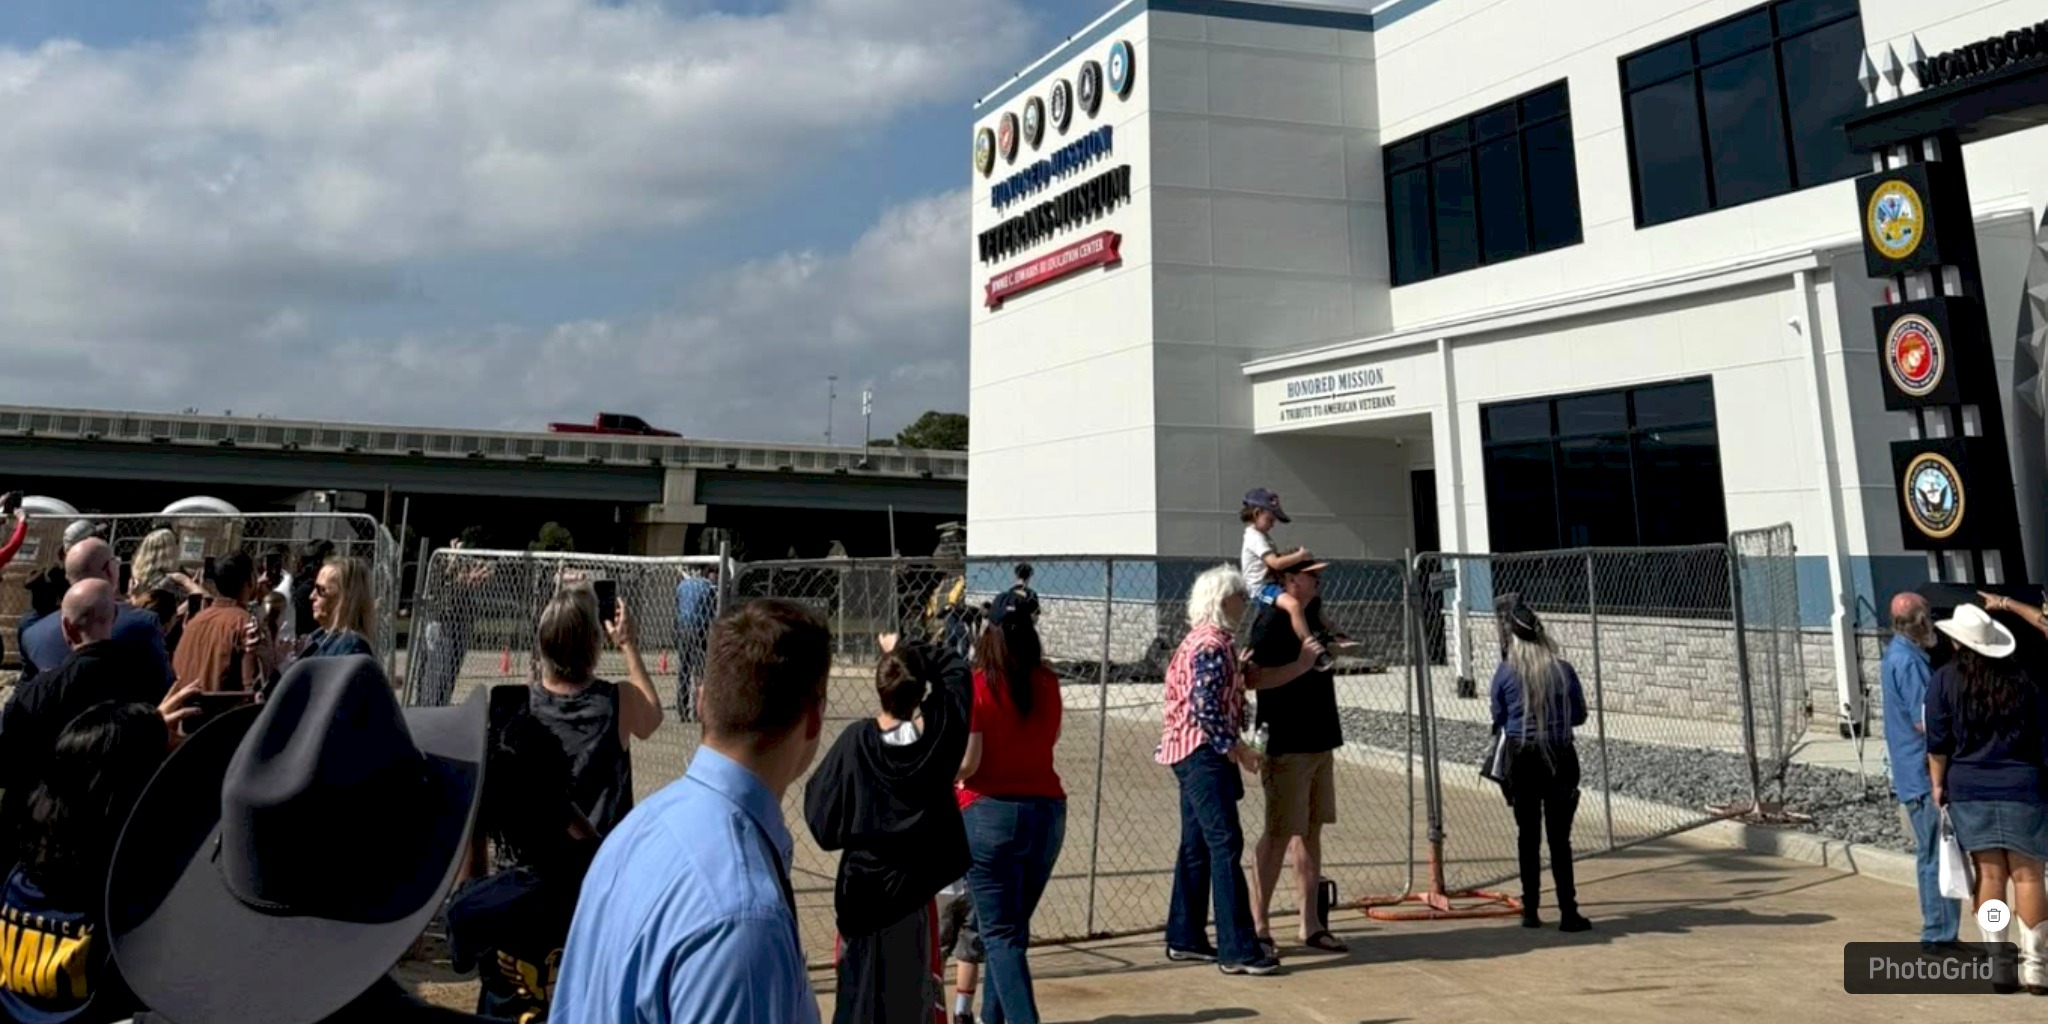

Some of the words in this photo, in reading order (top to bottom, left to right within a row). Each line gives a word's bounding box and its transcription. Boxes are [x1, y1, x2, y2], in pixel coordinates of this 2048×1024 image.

[978, 200, 1054, 263] VETERANS
[1054, 164, 1131, 228] MUSEUM
[1079, 237, 1104, 259] CENTER
[1287, 375, 1336, 398] HONORED
[1338, 367, 1384, 391] MISSION
[1280, 410, 1285, 421] A
[1285, 406, 1312, 421] TRIBUTE
[1313, 404, 1322, 417] TO
[1324, 399, 1358, 415] AMERICAN
[1359, 394, 1396, 410] VETERANS
